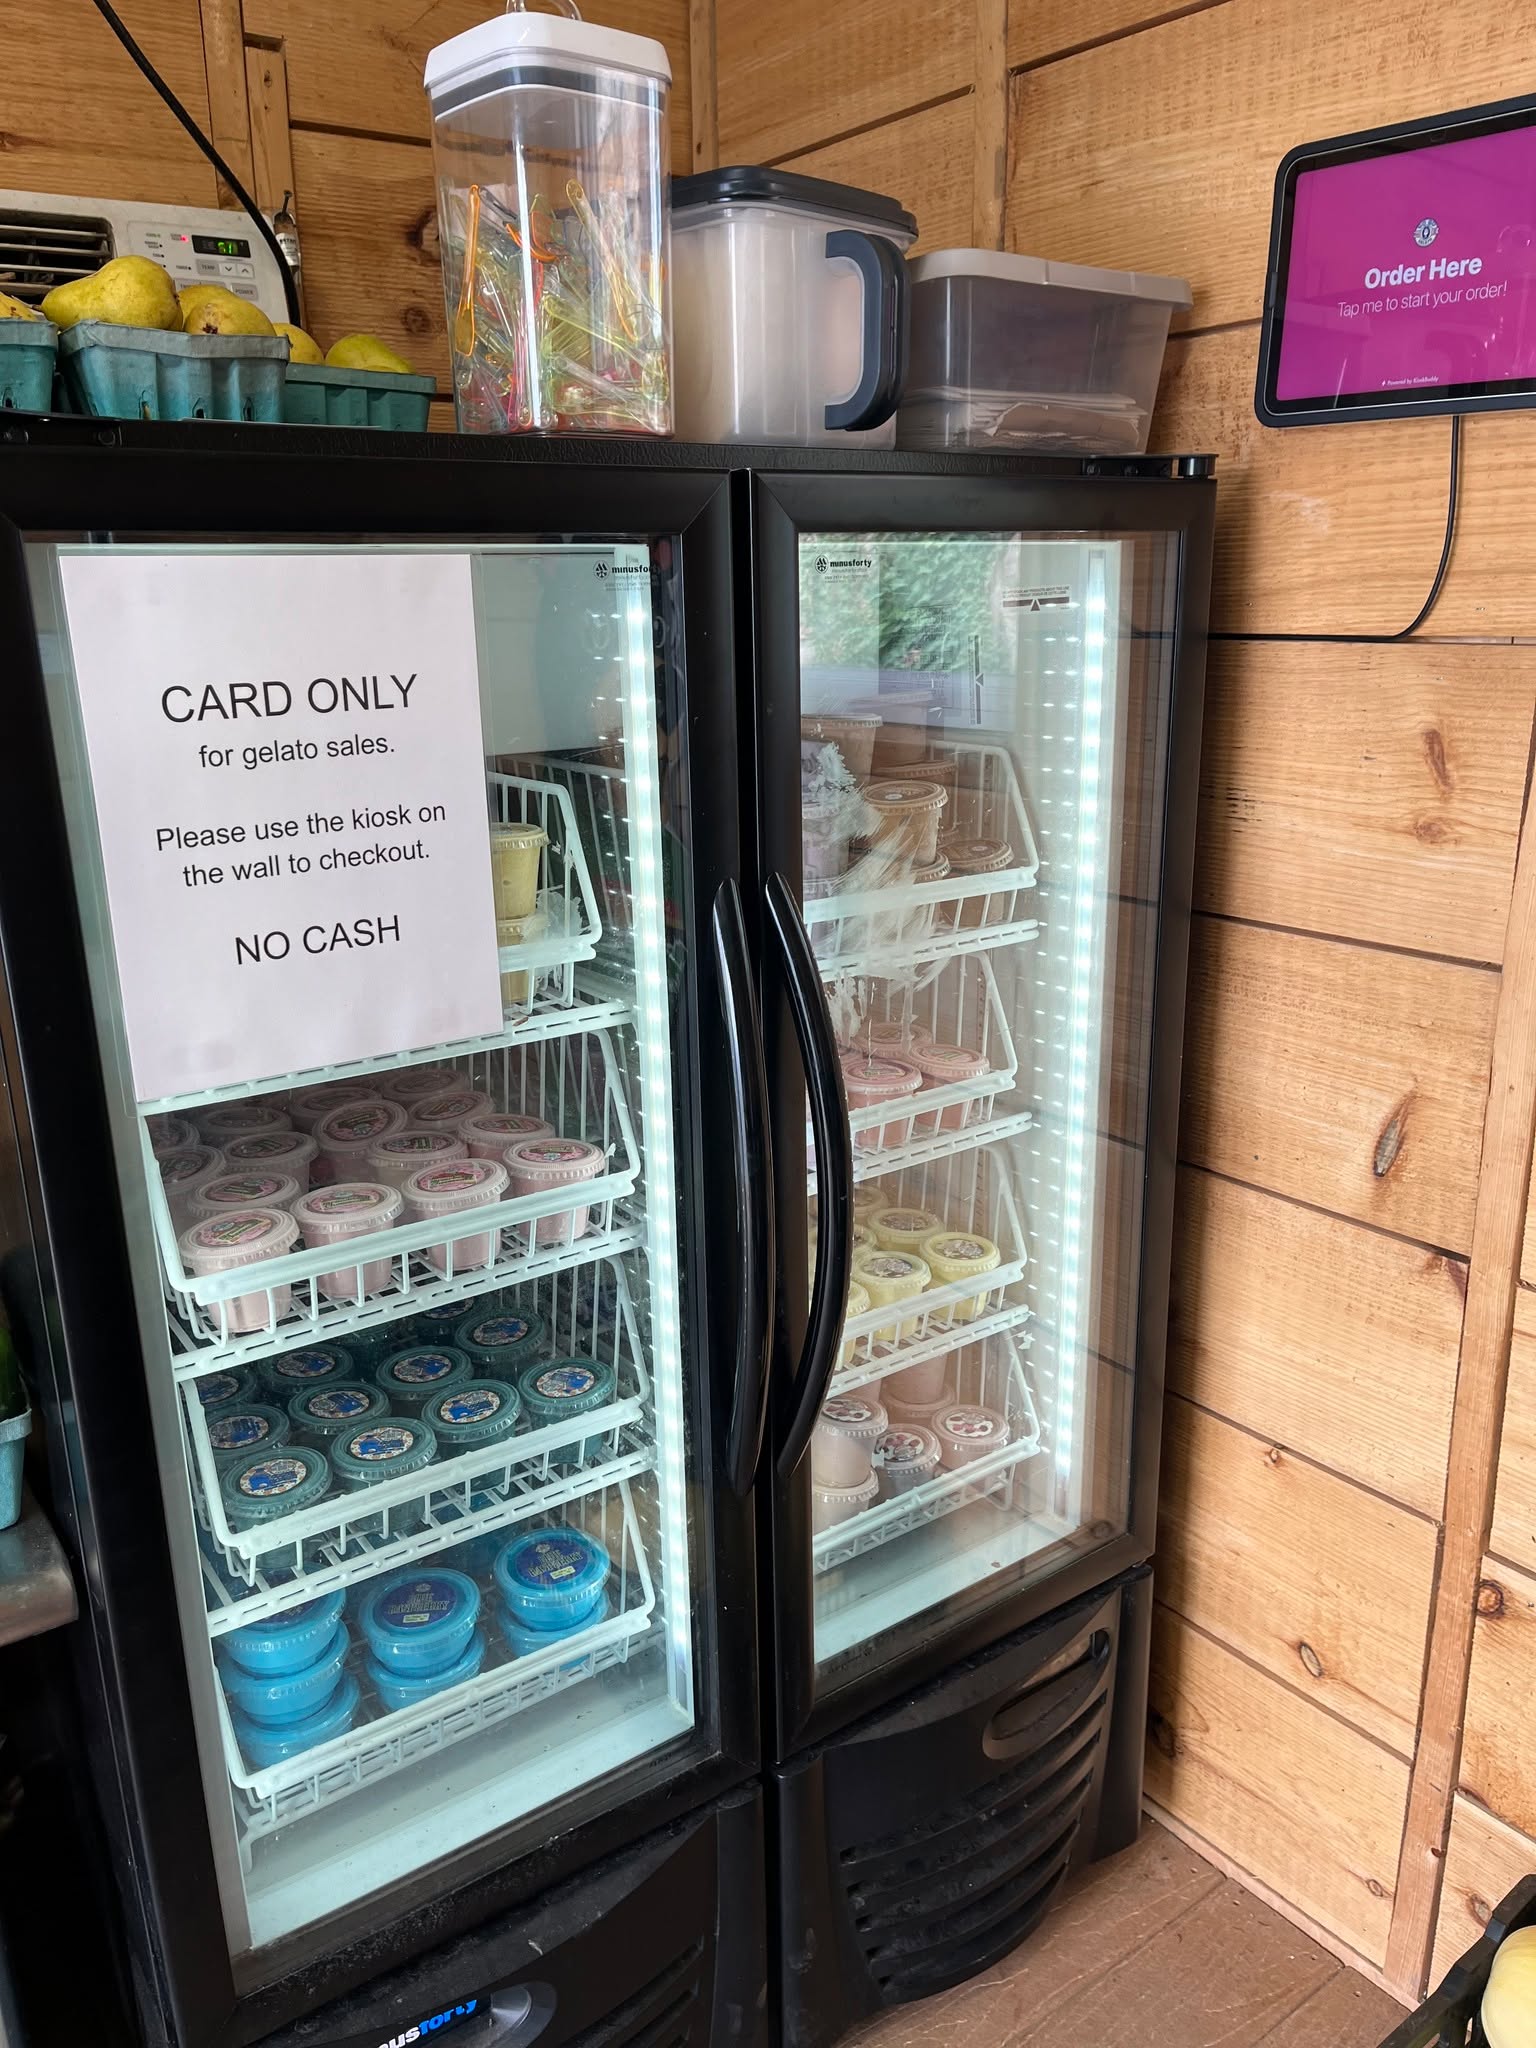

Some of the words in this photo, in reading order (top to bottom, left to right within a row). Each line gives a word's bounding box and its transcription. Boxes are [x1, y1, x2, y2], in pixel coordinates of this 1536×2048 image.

[1364, 264, 1424, 289] Order
[1428, 256, 1483, 281] Here
[1338, 301, 1360, 319] Tap
[1362, 299, 1383, 313] me
[1386, 296, 1398, 311] to
[1400, 292, 1430, 309] start
[1432, 287, 1465, 308] your
[1466, 281, 1509, 301] order!
[829, 558, 872, 569] minusforty
[161, 680, 293, 723] CARD
[307, 673, 418, 714] ONLY
[198, 744, 234, 768] for
[242, 739, 319, 771] gelato
[326, 733, 395, 758] sales.
[156, 822, 246, 852] Please
[254, 820, 299, 841] use
[306, 812, 344, 835] the
[351, 804, 412, 831] kiosk
[418, 805, 446, 823] on
[182, 861, 224, 887] the
[231, 854, 281, 881] wall
[288, 852, 311, 874] to
[319, 839, 430, 872] checkout.
[235, 931, 291, 966] NO
[302, 914, 401, 955] CASH
